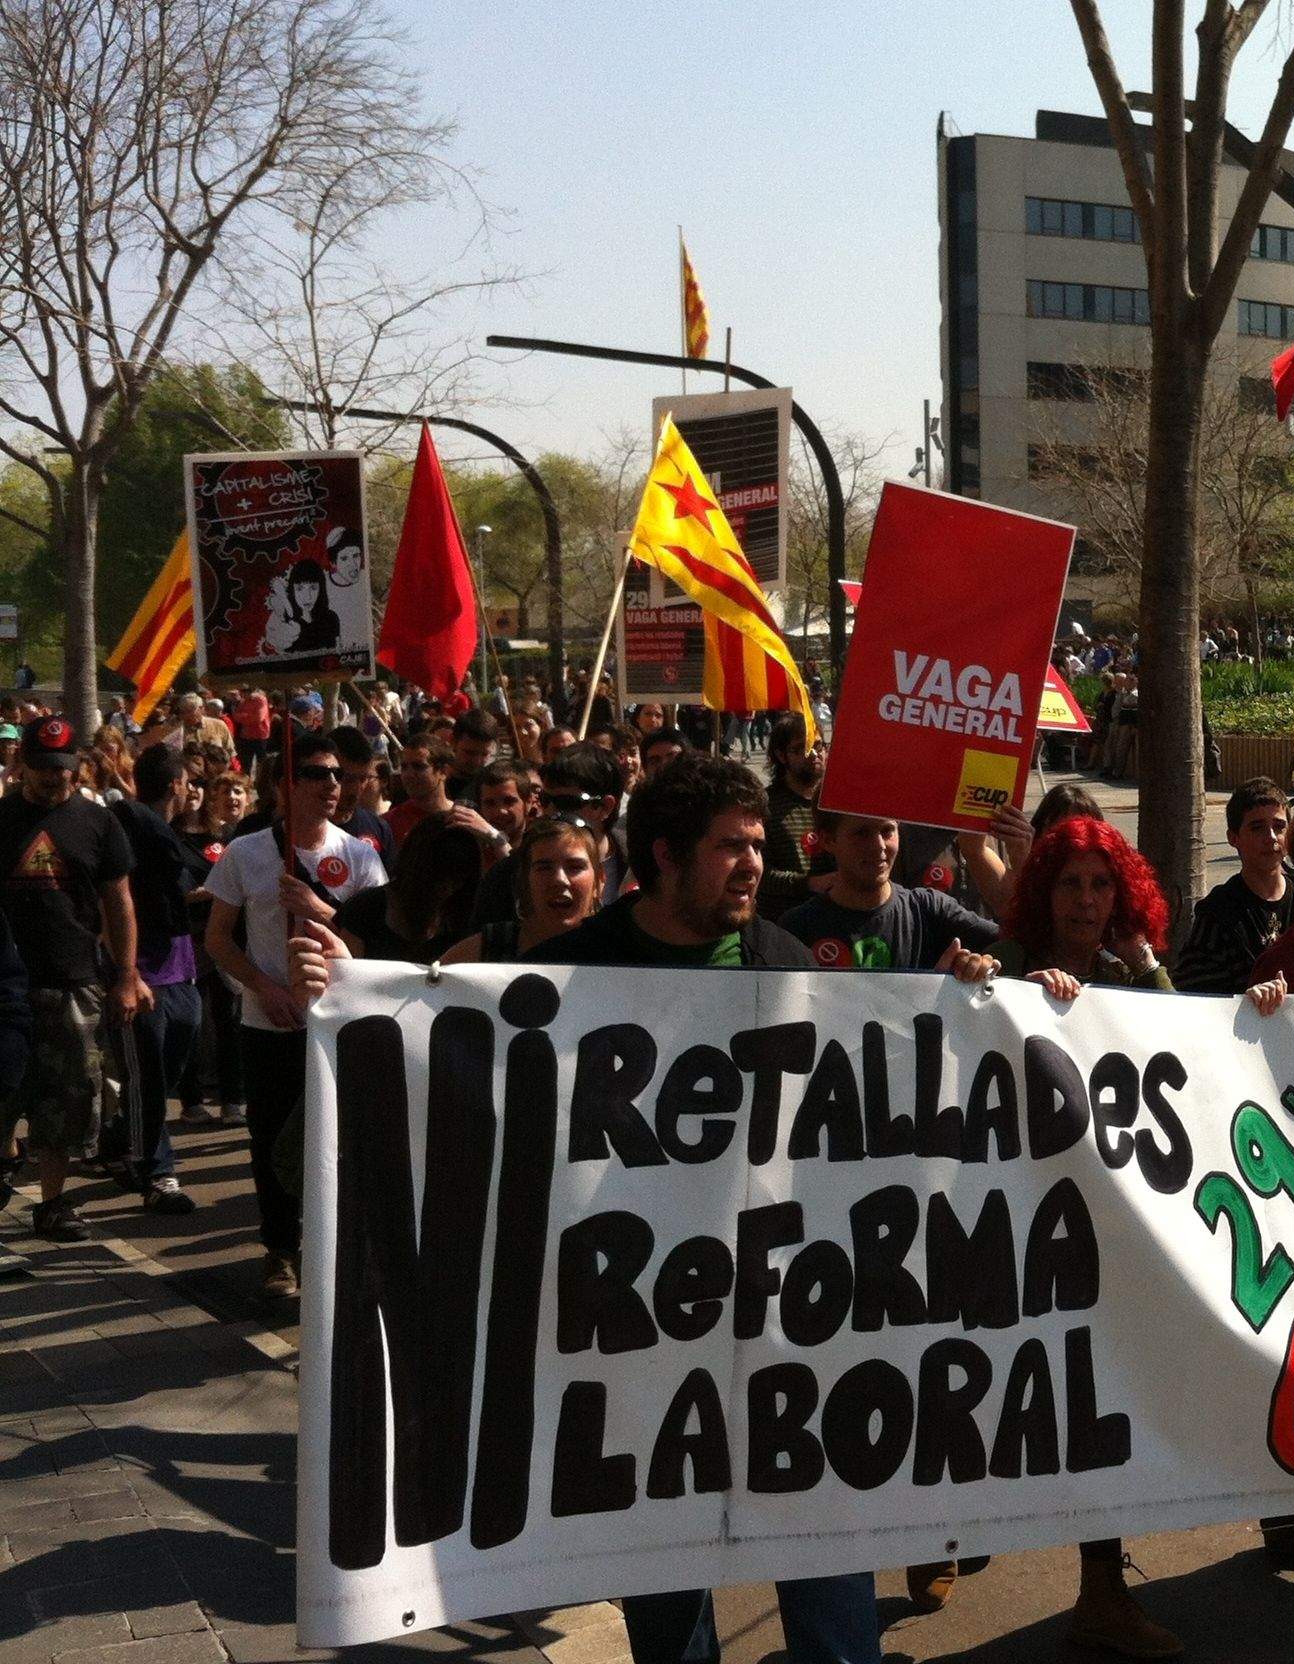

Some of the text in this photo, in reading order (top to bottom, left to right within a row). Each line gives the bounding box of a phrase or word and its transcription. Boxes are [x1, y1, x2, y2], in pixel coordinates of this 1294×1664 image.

[201, 470, 310, 496] CAPITALISME
[626, 611, 658, 623] VAGA
[894, 650, 1022, 716] VAGA
[879, 694, 1022, 744] GENERAL
[551, 1326, 1131, 1517] LABORAL
